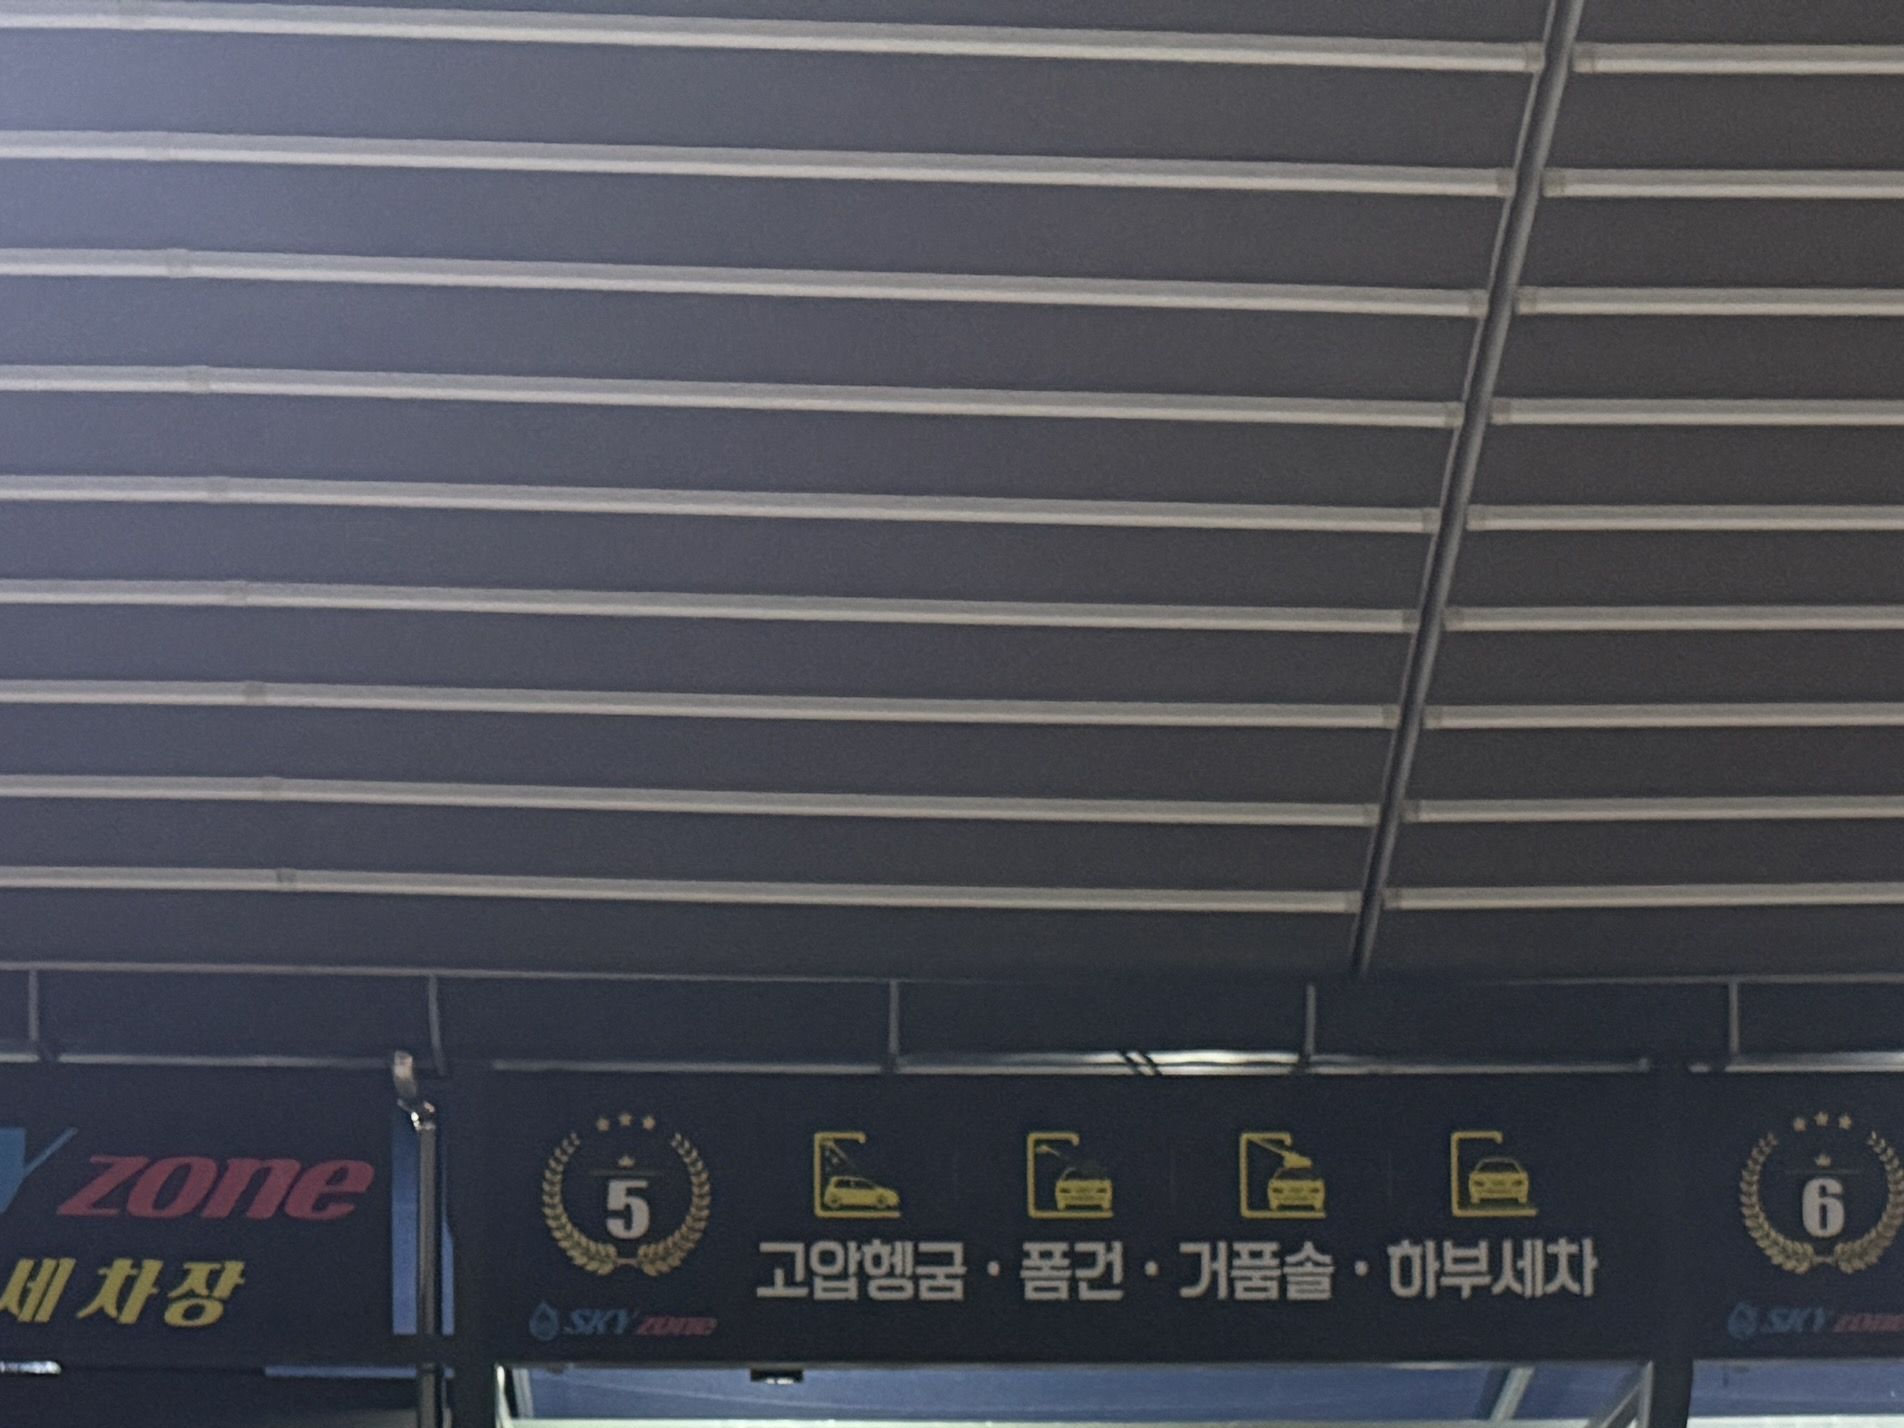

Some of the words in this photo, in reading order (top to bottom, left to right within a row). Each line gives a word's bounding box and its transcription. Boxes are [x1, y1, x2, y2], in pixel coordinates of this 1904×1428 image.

[57, 1155, 374, 1219] zone
[607, 1180, 649, 1238] 5
[1803, 1178, 1844, 1237] 6
[757, 1239, 966, 1300] 고압헹굼
[1020, 1241, 1123, 1300] 폼건
[1180, 1241, 1334, 1300] 거품솔
[1387, 1238, 1598, 1298] 하부세차
